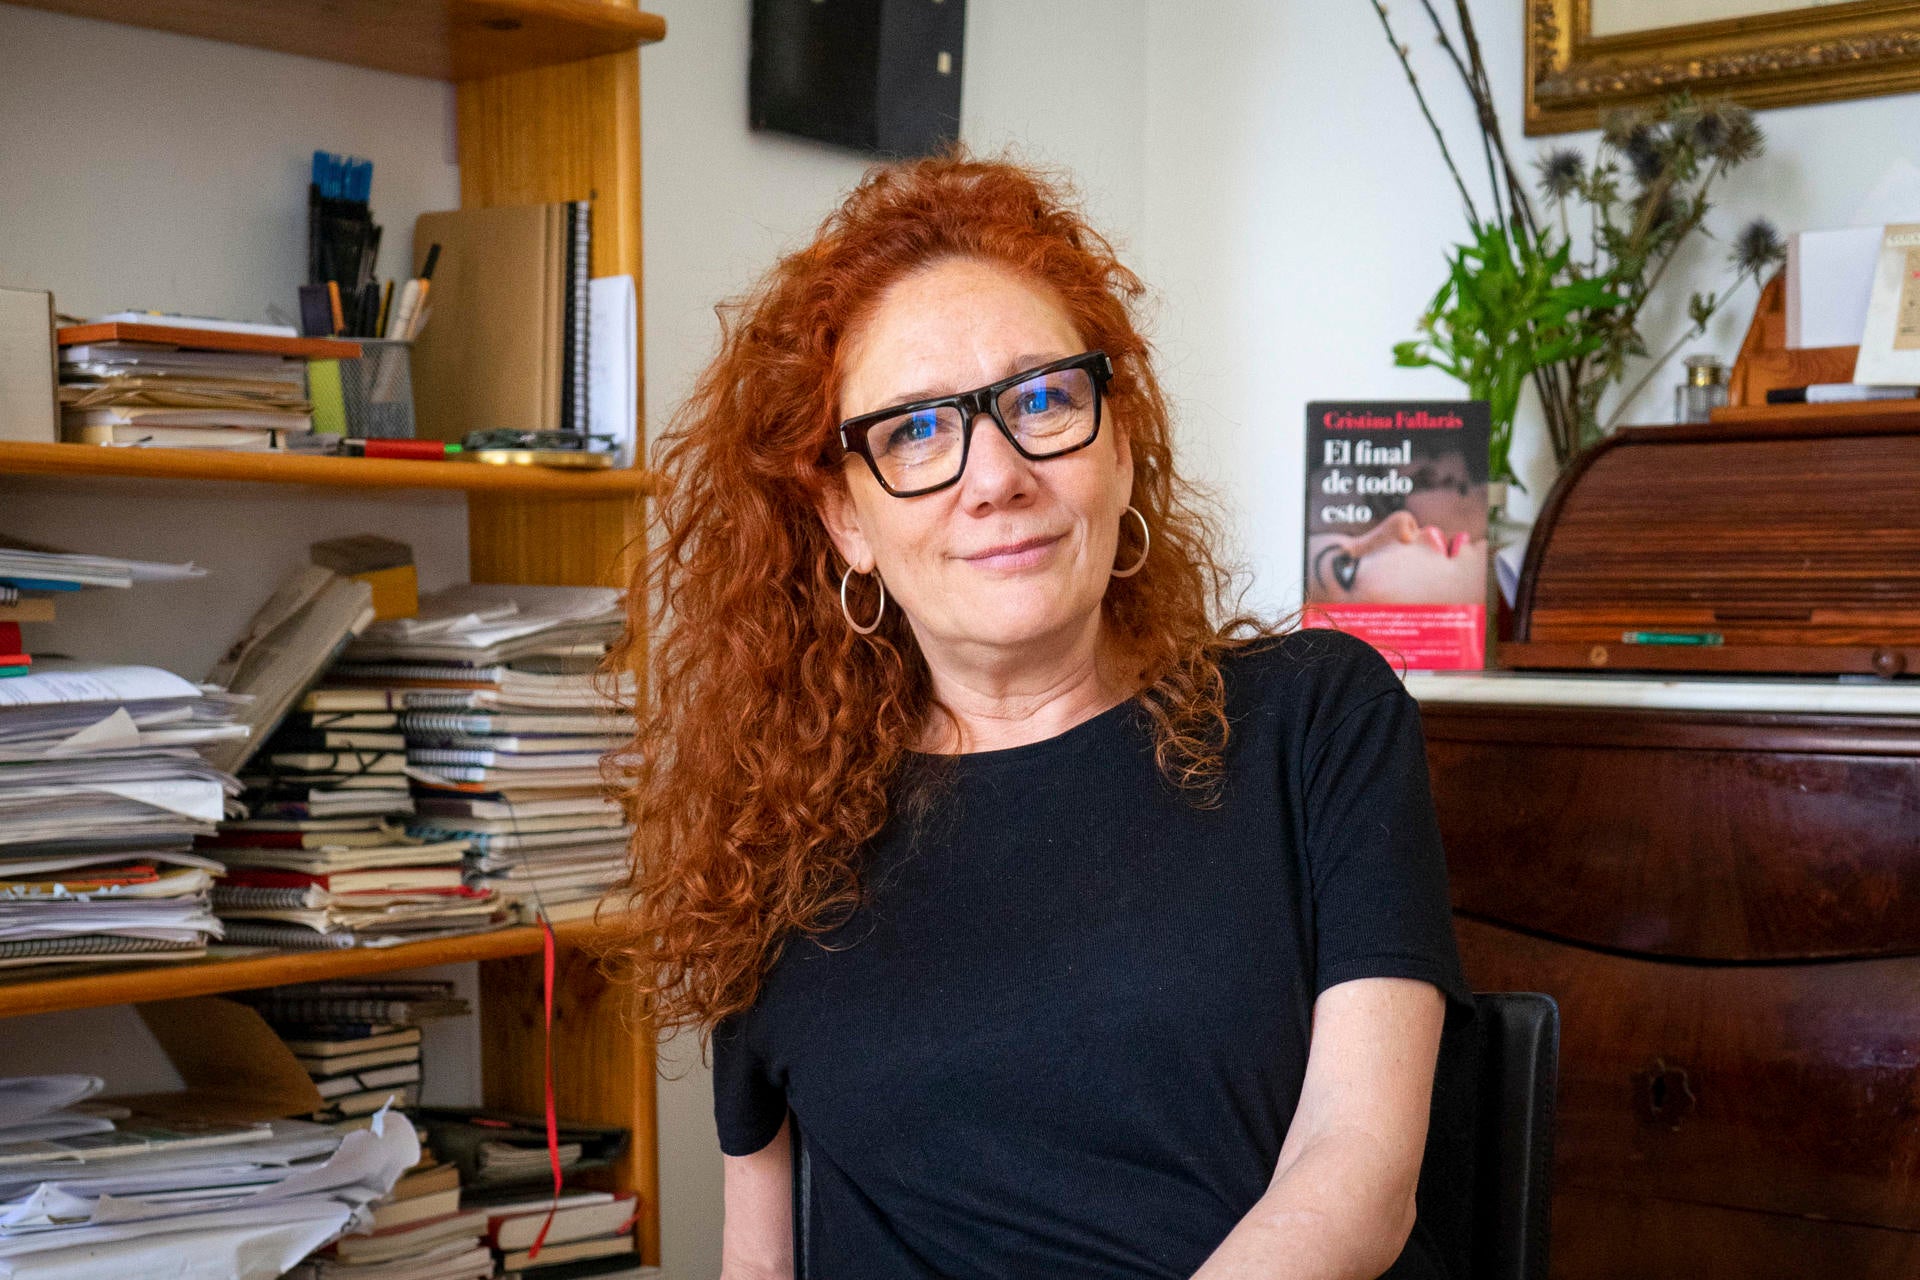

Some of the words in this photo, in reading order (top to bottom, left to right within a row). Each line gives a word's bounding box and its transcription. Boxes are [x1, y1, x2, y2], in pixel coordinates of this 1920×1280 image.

[1323, 411, 1394, 429] Cristina
[1323, 439, 1351, 465] El
[1355, 439, 1412, 465] final
[1321, 469, 1353, 494] de
[1356, 469, 1413, 494] todo
[1321, 503, 1373, 523] esto
